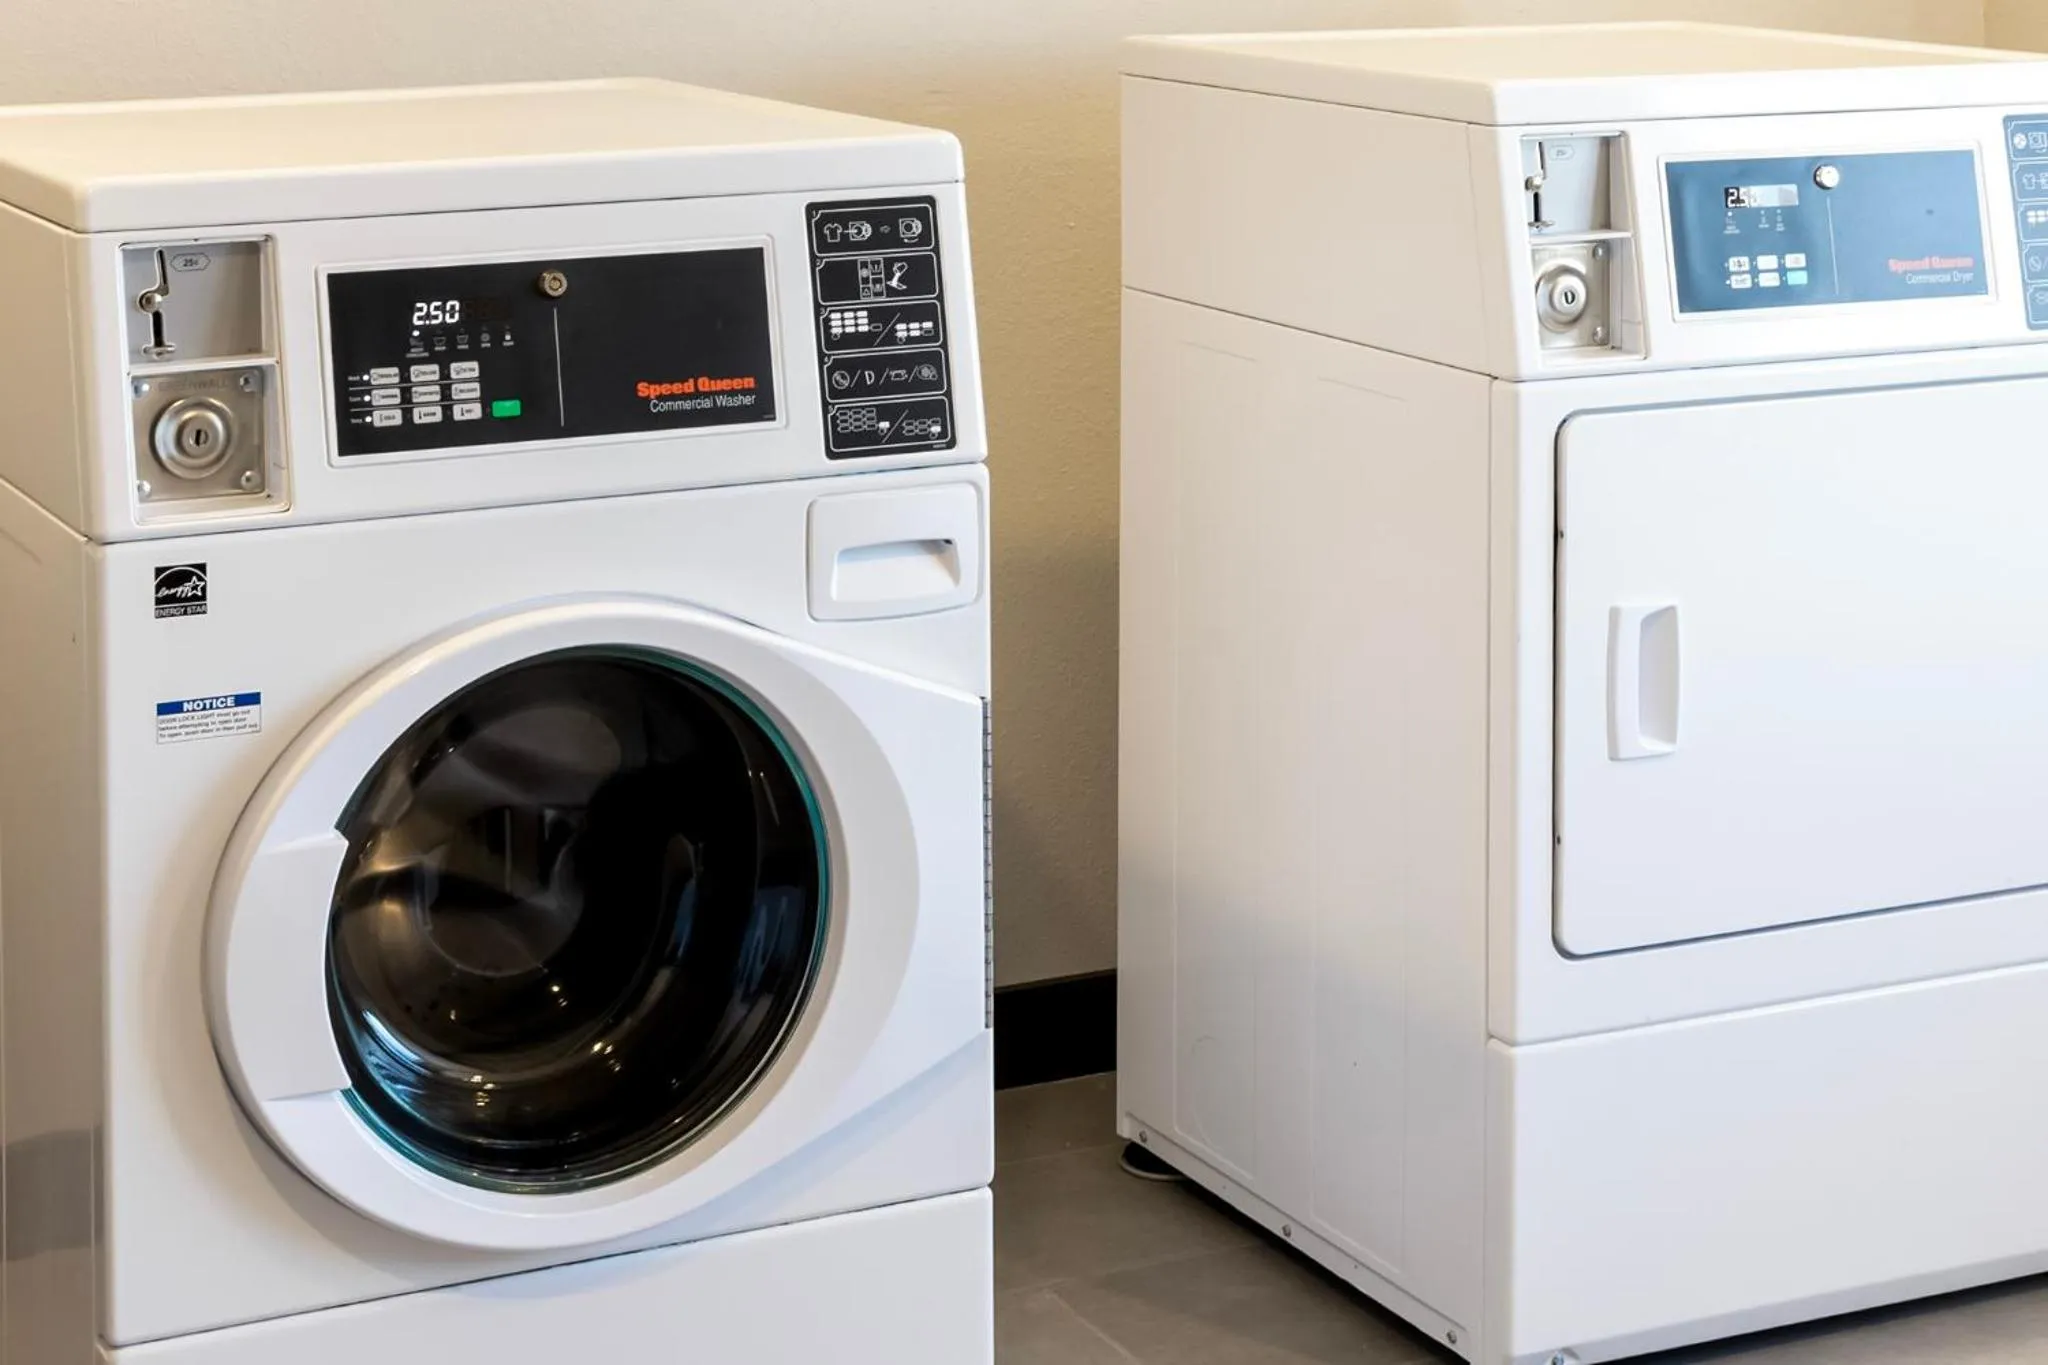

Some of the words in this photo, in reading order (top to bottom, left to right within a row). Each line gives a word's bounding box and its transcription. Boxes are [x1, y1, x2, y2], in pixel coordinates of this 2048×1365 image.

[1906, 272, 1951, 284] Commercial
[413, 300, 460, 325] 2.50
[636, 378, 694, 400] Speed
[697, 376, 755, 392] Queen
[650, 396, 714, 412] Commercial
[715, 394, 756, 408] Washer
[155, 606, 186, 618] ENERGY
[186, 604, 207, 615] STAR
[182, 696, 236, 712] NOTICE
